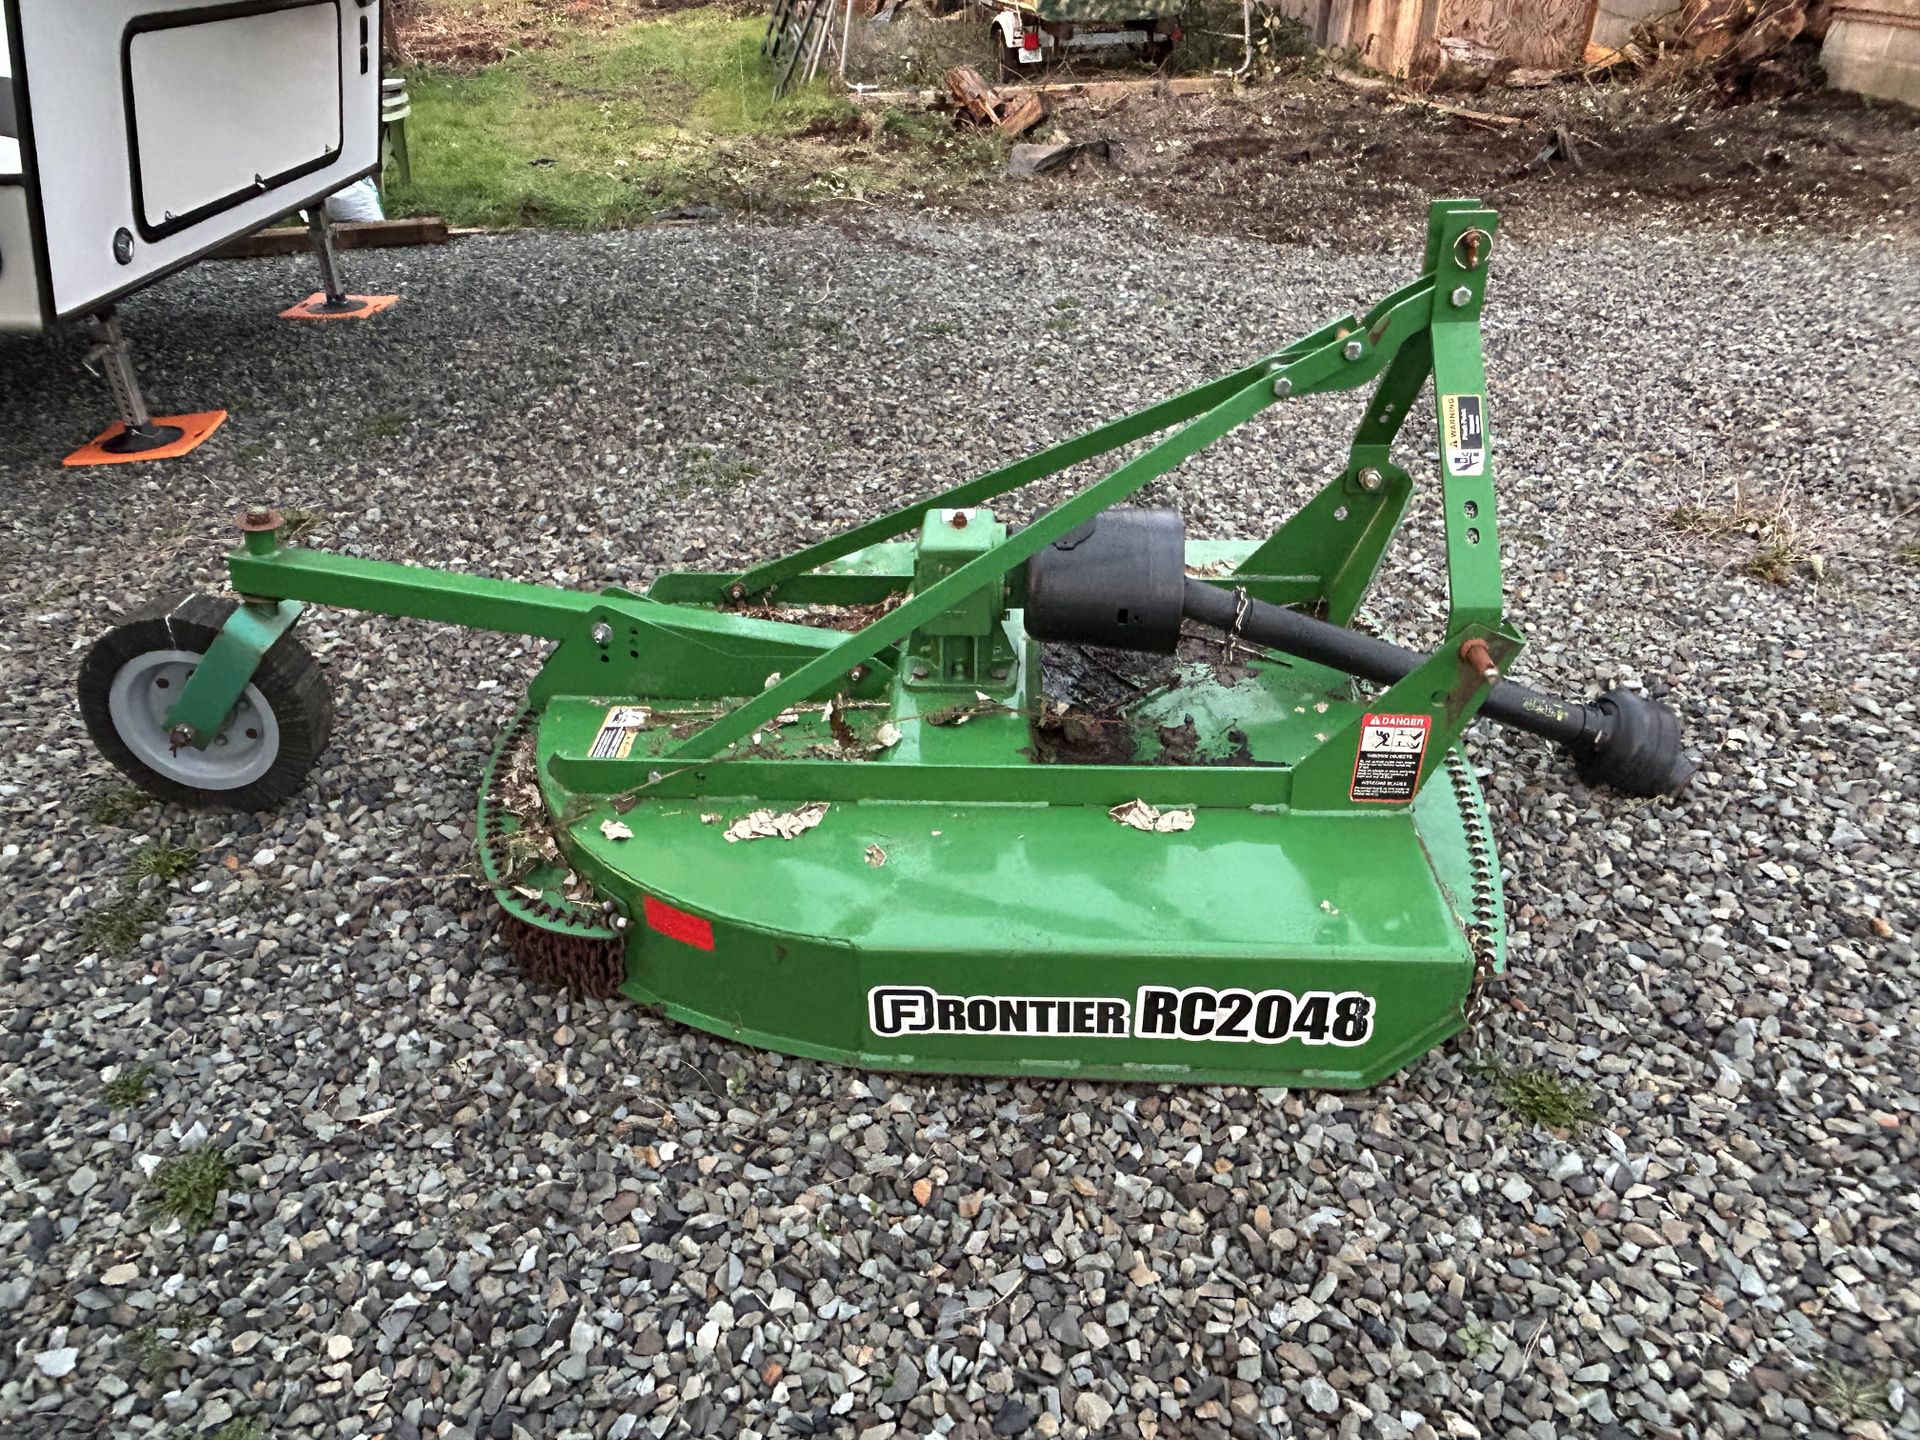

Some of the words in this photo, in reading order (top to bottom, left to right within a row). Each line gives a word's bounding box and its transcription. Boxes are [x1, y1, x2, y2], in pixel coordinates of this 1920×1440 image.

[1448, 398, 1457, 438] WARNING
[1382, 717, 1424, 726] DANGER
[873, 989, 1126, 1034] FRONTIER
[1141, 990, 1370, 1042] RC2048
